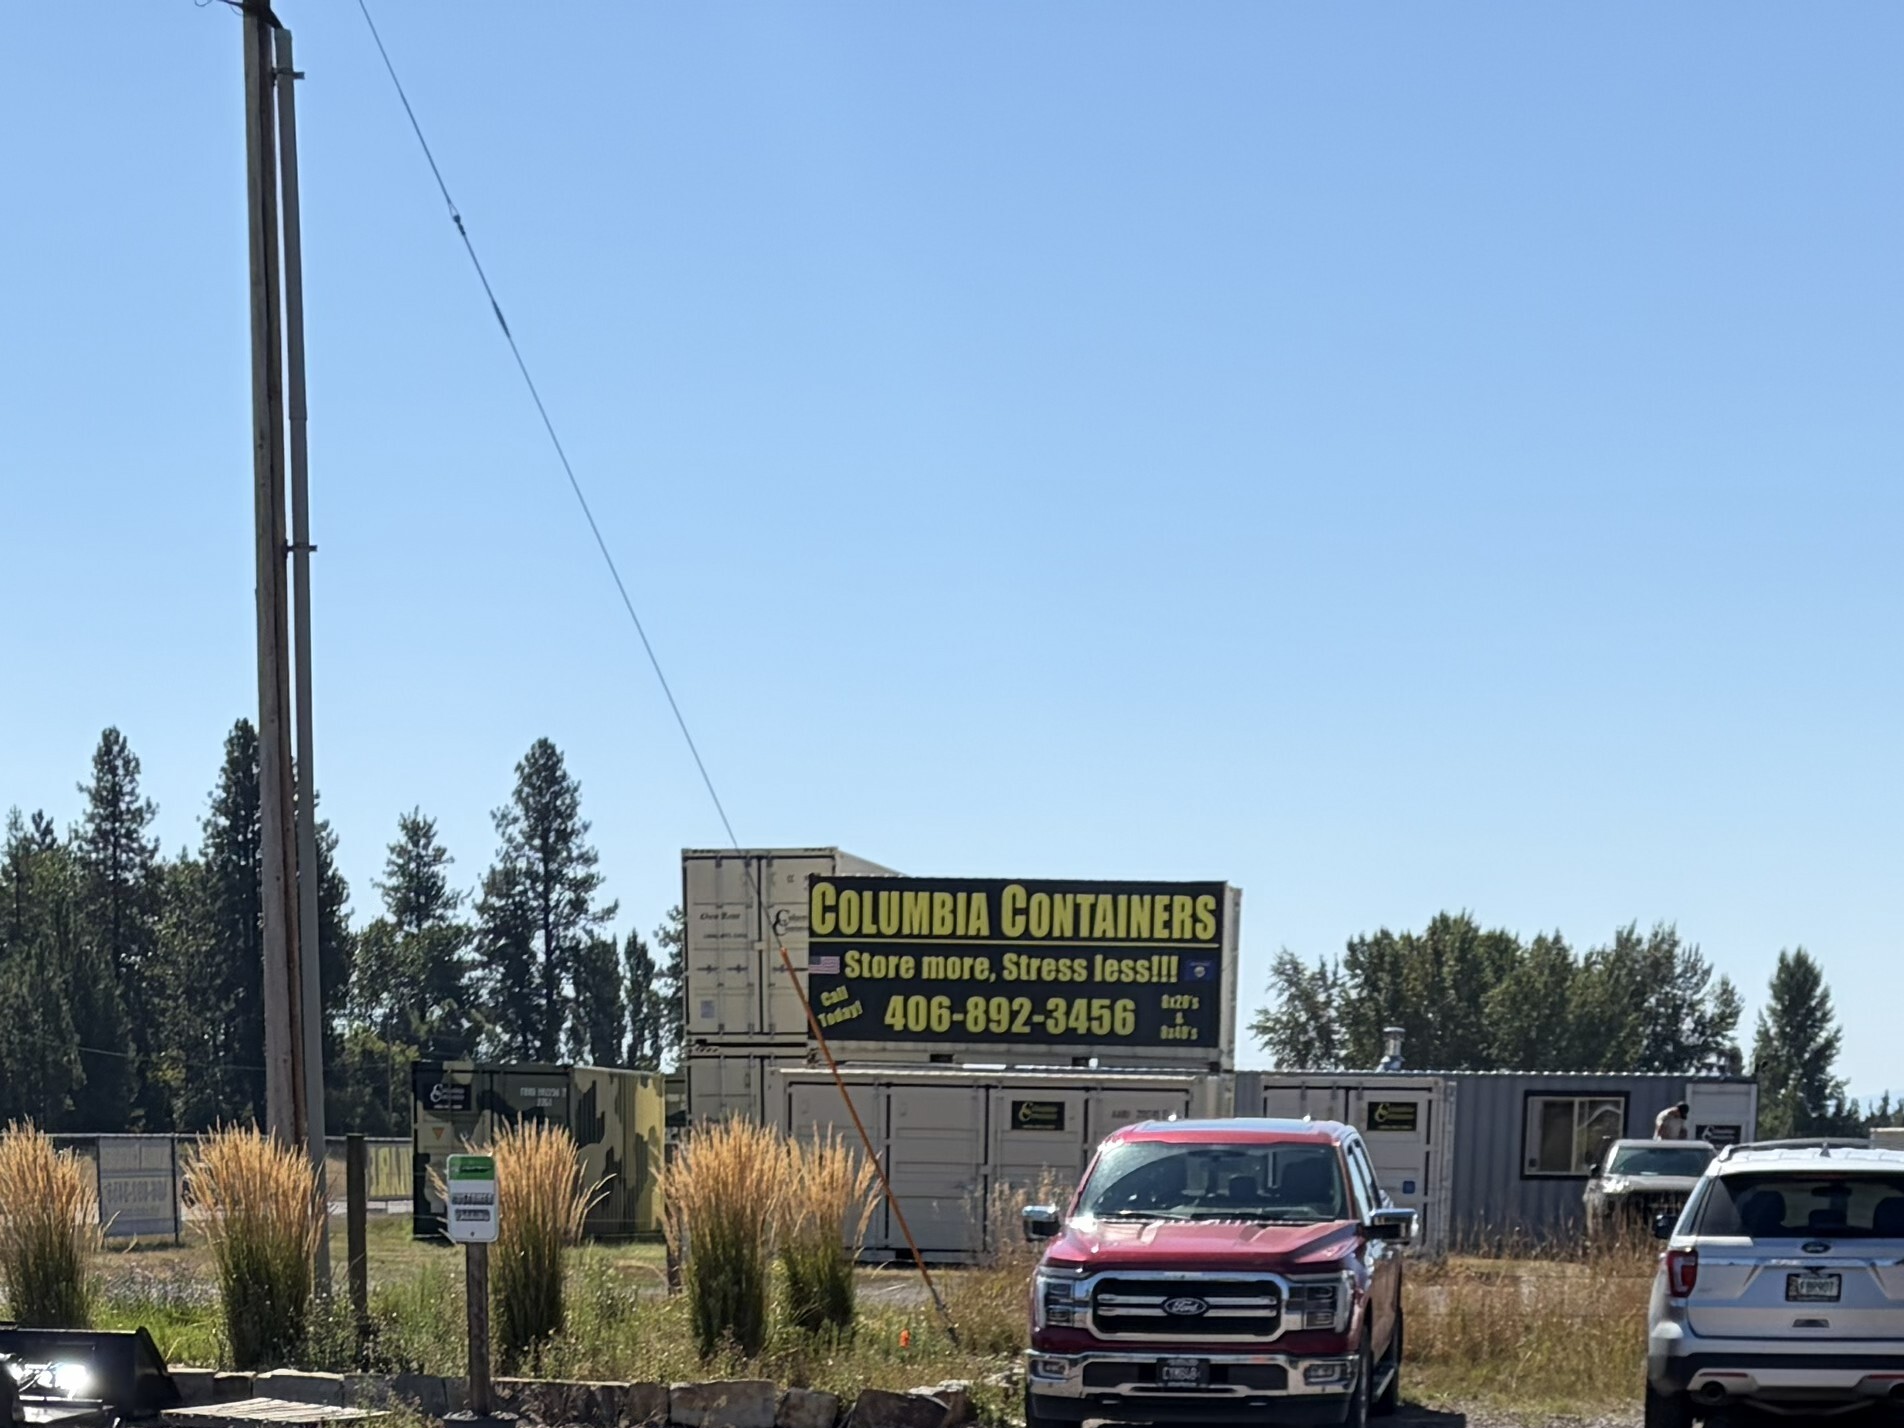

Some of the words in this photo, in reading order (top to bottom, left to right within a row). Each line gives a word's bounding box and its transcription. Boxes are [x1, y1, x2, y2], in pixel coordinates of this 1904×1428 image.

[811, 882, 990, 937] COLUMBIA
[1001, 884, 1217, 940] CONTAINERS
[845, 950, 915, 979] Store
[922, 954, 997, 984] more,
[1003, 953, 1088, 983] Stress
[1094, 954, 1179, 984] less!!!
[821, 985, 849, 1007] Call
[817, 1000, 863, 1028] Today!
[884, 994, 1135, 1036] 406-892-3456
